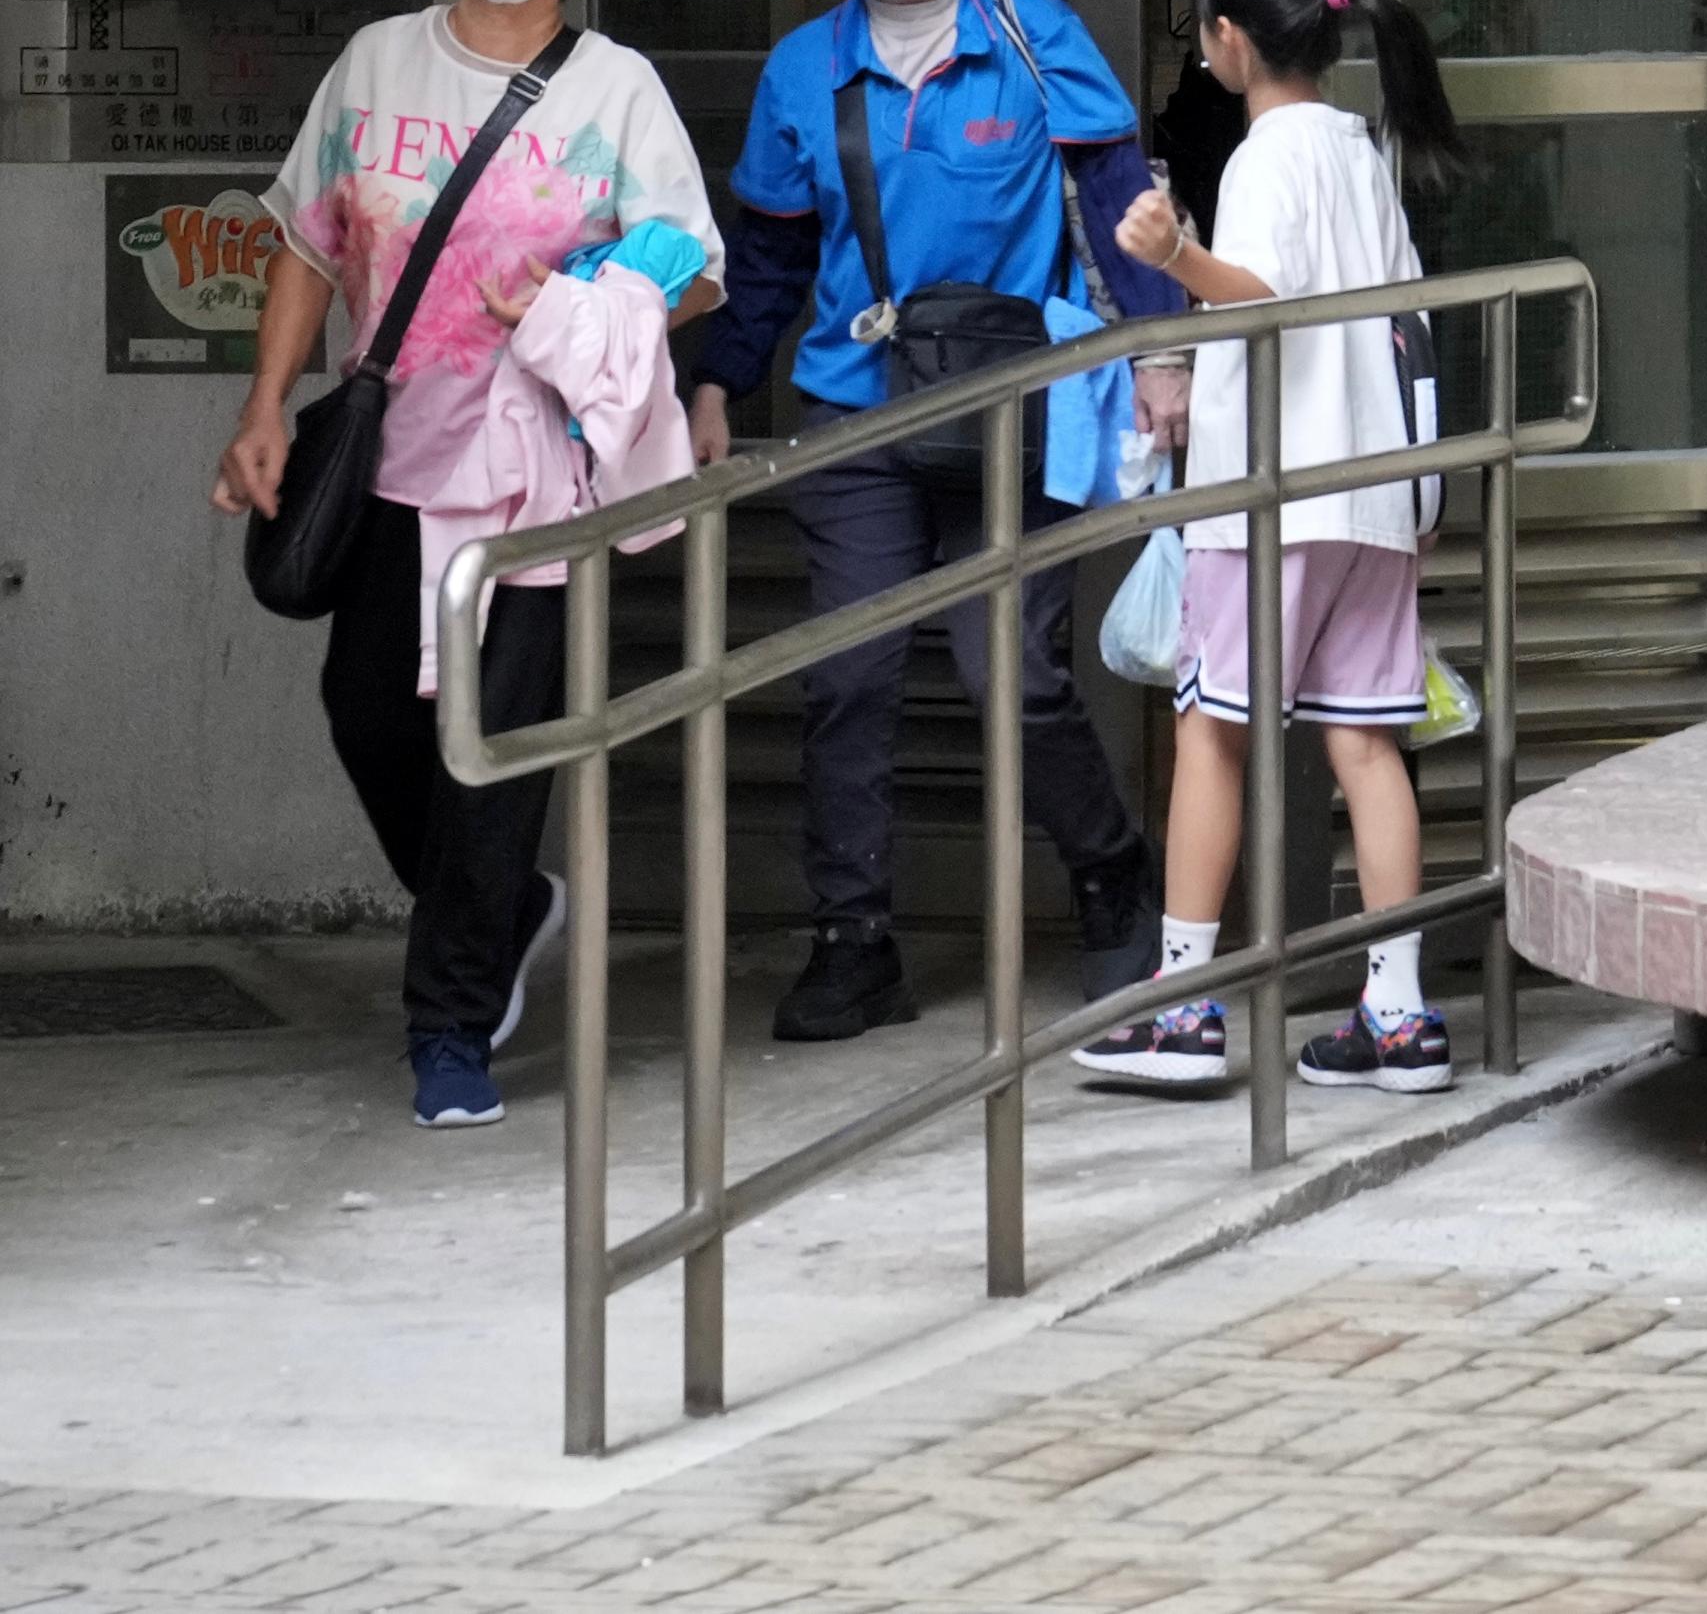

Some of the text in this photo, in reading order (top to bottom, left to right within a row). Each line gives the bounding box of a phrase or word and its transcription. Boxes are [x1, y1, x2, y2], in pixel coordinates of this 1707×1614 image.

[111, 135, 128, 152] OI
[134, 135, 167, 152] TAK
[173, 134, 231, 152] HOUSE
[129, 231, 161, 243] Free
